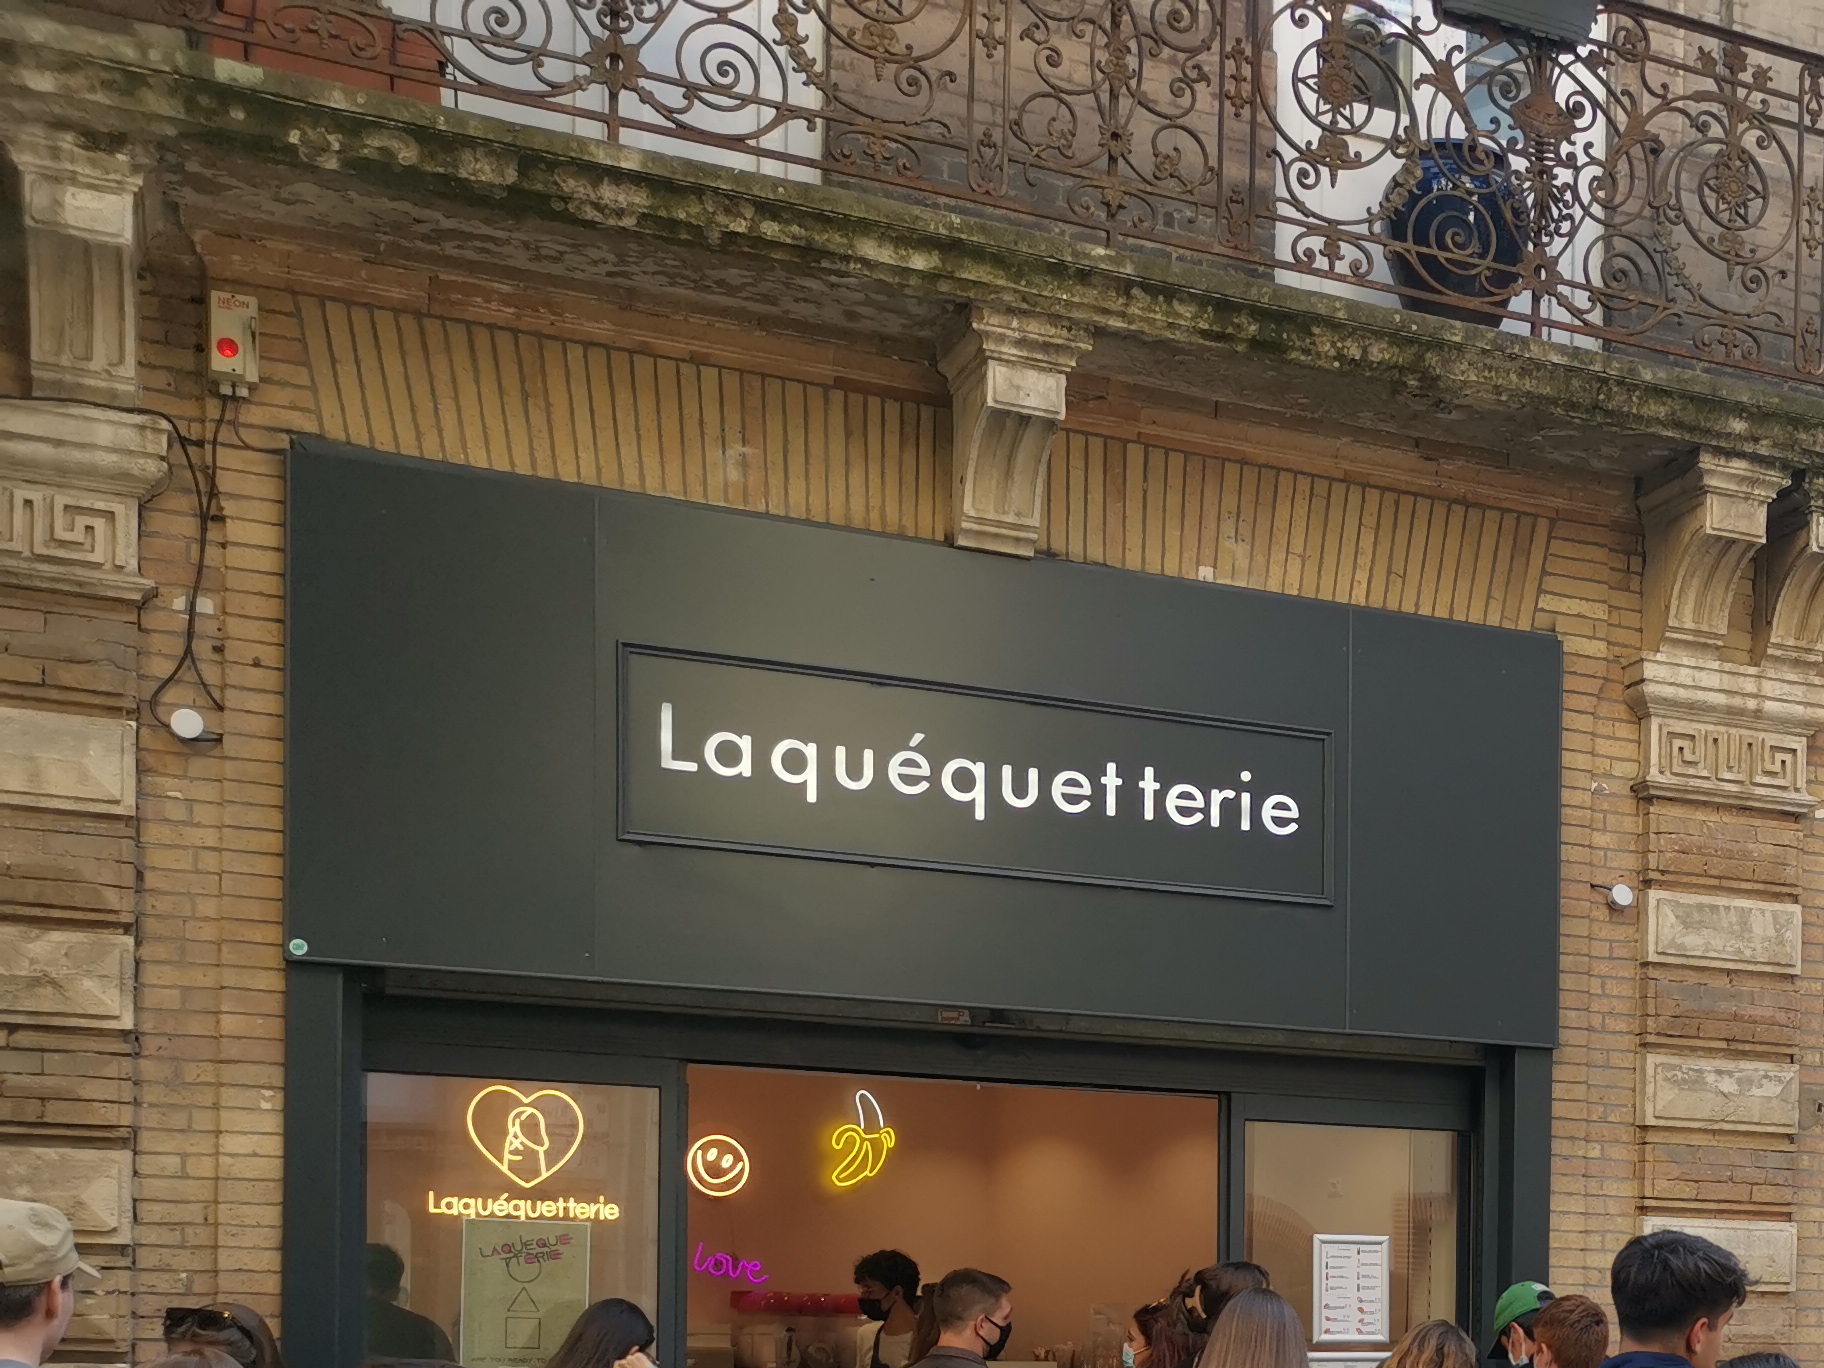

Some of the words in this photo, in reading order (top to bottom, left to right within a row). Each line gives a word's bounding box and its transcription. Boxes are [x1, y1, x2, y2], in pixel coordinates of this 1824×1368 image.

[217, 296, 250, 309] NEON
[428, 1190, 620, 1221] Laquéquetterie
[694, 1241, 769, 1284] love
